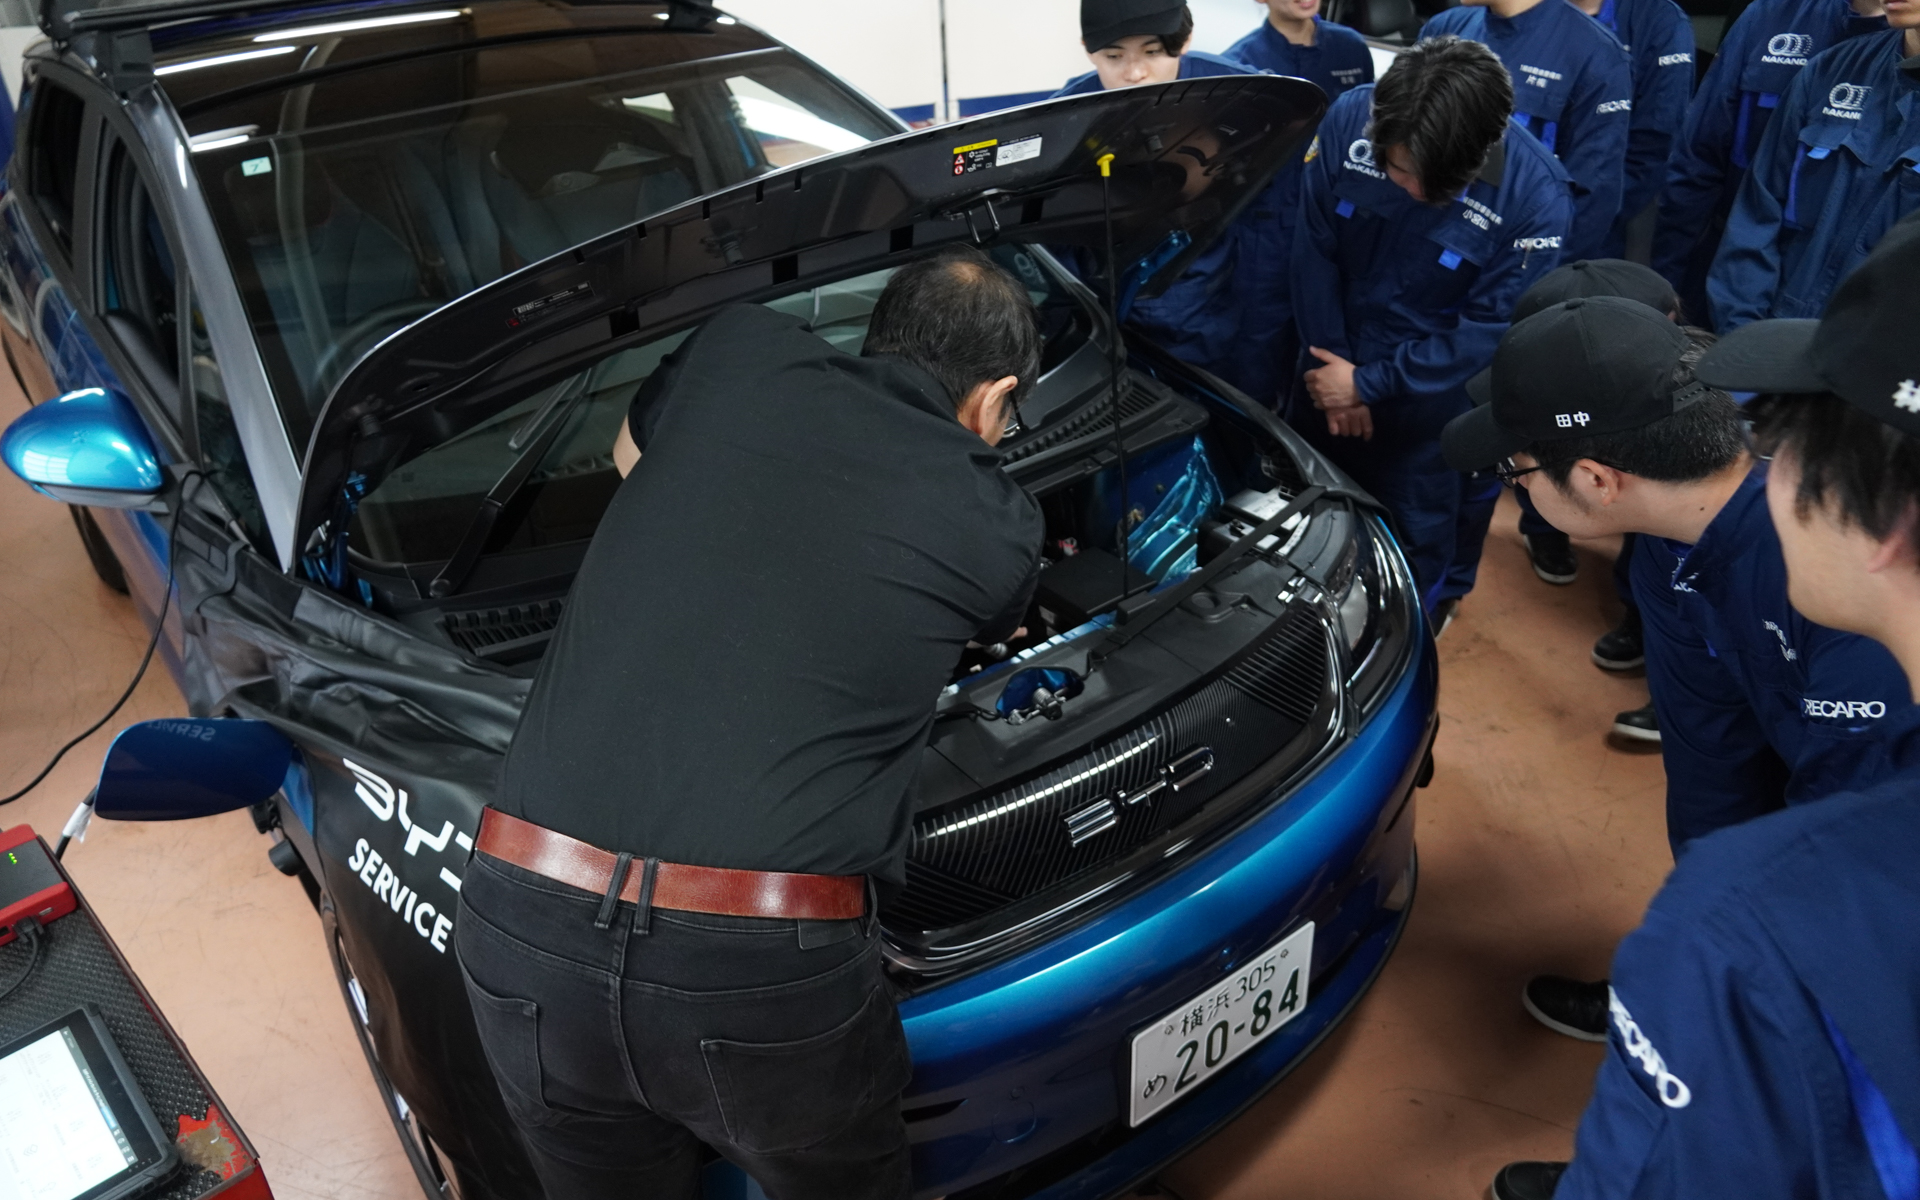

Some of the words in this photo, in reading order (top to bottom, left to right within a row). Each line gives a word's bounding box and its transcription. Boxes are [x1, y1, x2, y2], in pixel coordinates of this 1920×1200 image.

[1761, 55, 1808, 66] NAKANO
[1822, 106, 1862, 120] NAKAN
[1555, 410, 1591, 428] 田中
[1803, 698, 1886, 718] RECARO
[1064, 746, 1214, 848] BYD
[348, 837, 453, 954] SERVICE
[1180, 987, 1230, 1037] 横浜
[1234, 954, 1277, 1002] 305
[1143, 1073, 1168, 1099] め
[1174, 966, 1300, 1094] 20-84
